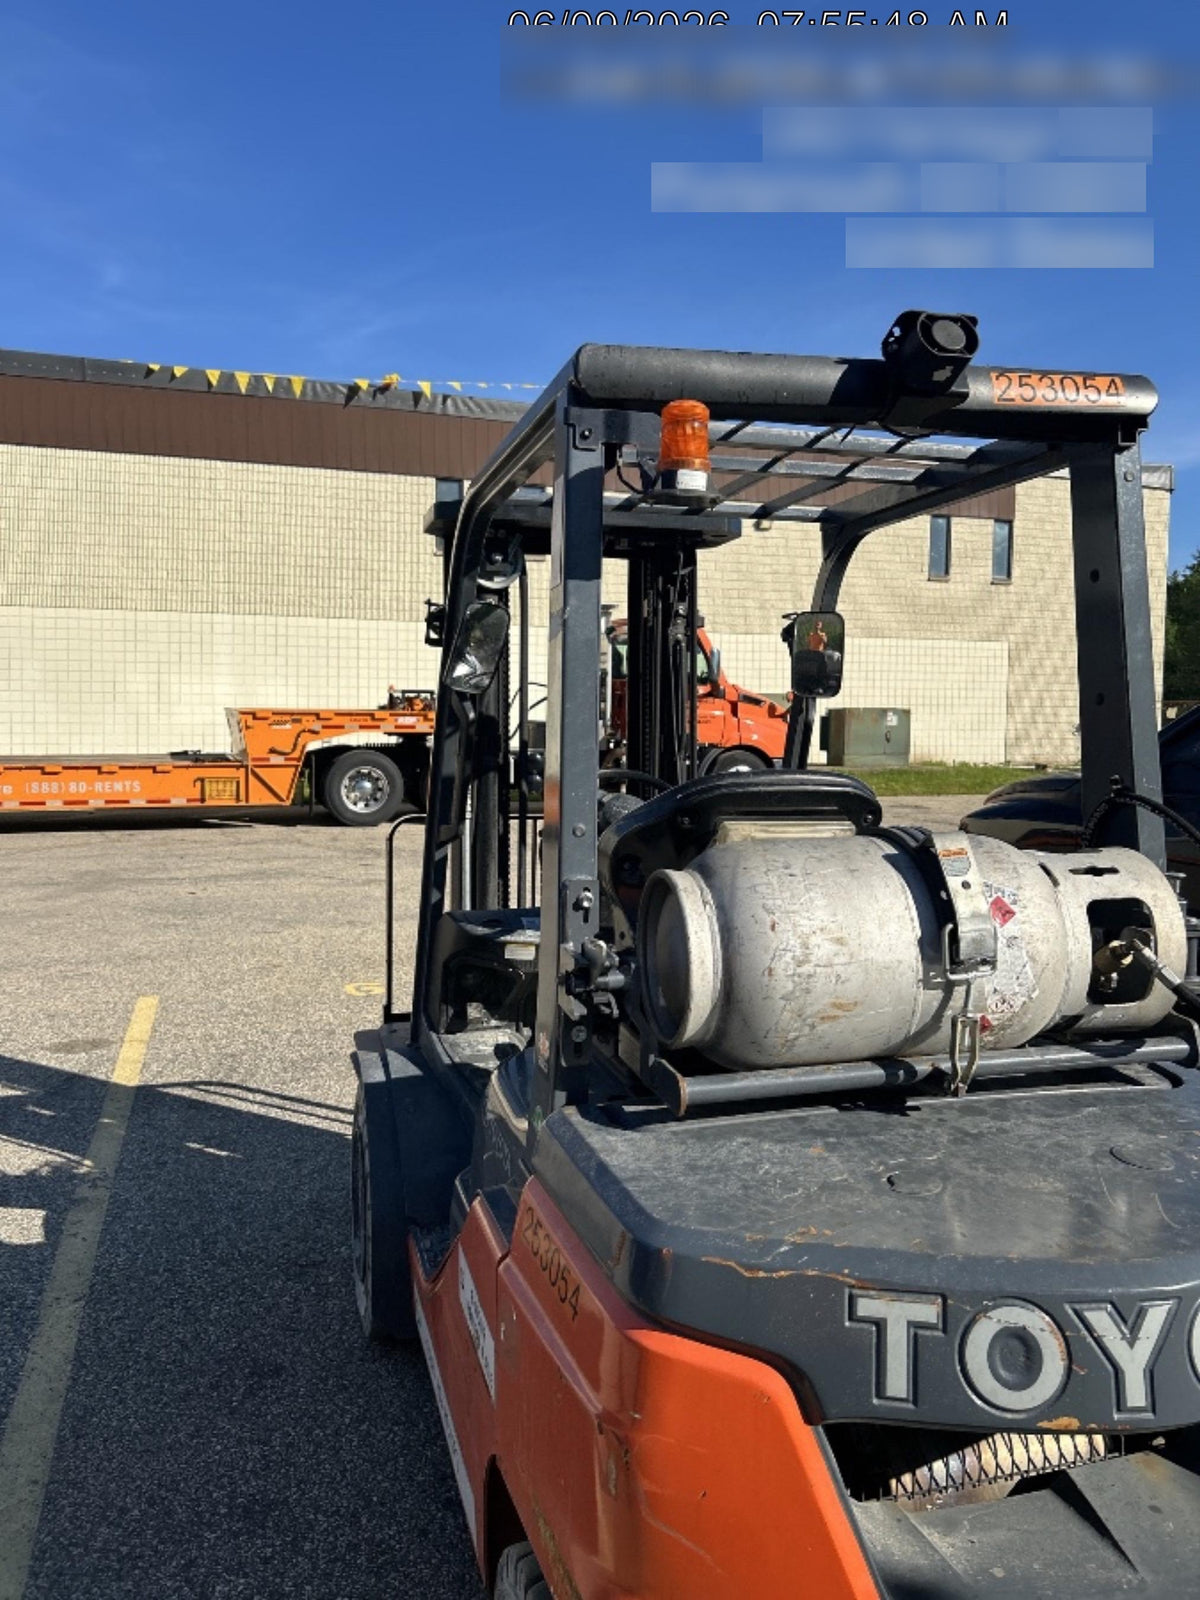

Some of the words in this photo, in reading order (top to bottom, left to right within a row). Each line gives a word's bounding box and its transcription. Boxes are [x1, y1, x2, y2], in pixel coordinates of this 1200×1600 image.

[995, 374, 1121, 403] 253054
[68, 780, 142, 793] 80-RENTS
[523, 1206, 581, 1322] 253054
[850, 1291, 1200, 1418] TOY
